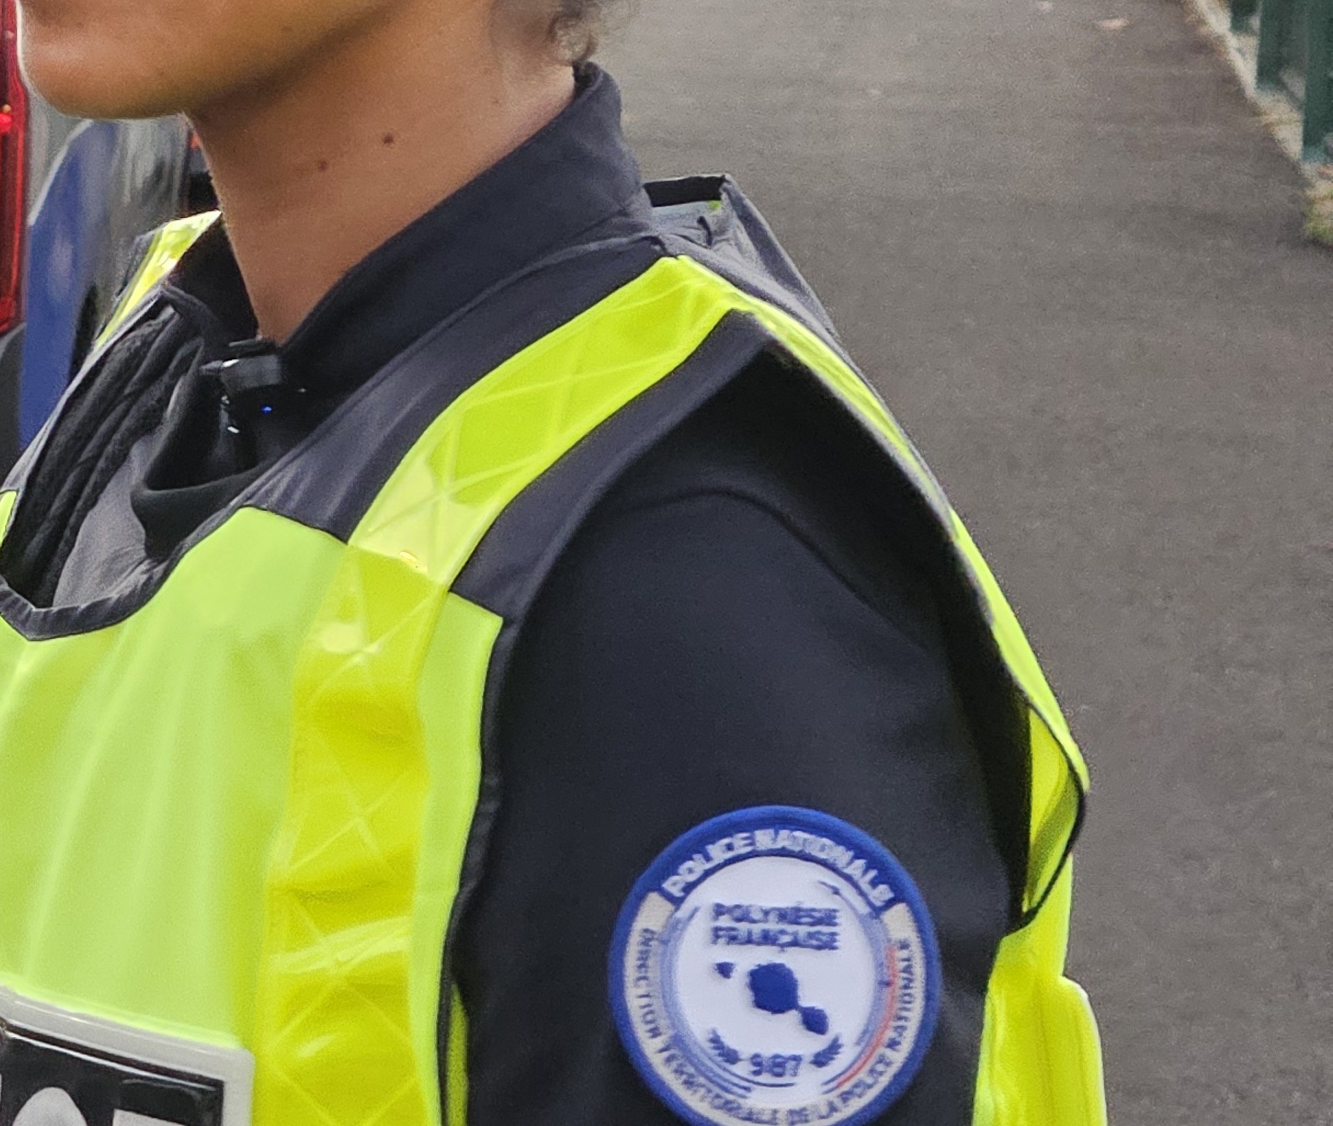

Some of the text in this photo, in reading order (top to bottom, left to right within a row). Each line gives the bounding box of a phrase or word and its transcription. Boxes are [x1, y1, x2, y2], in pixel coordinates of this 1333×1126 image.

[662, 828, 895, 907] POLICE NATIONALE
[749, 1053, 803, 1077] 987
